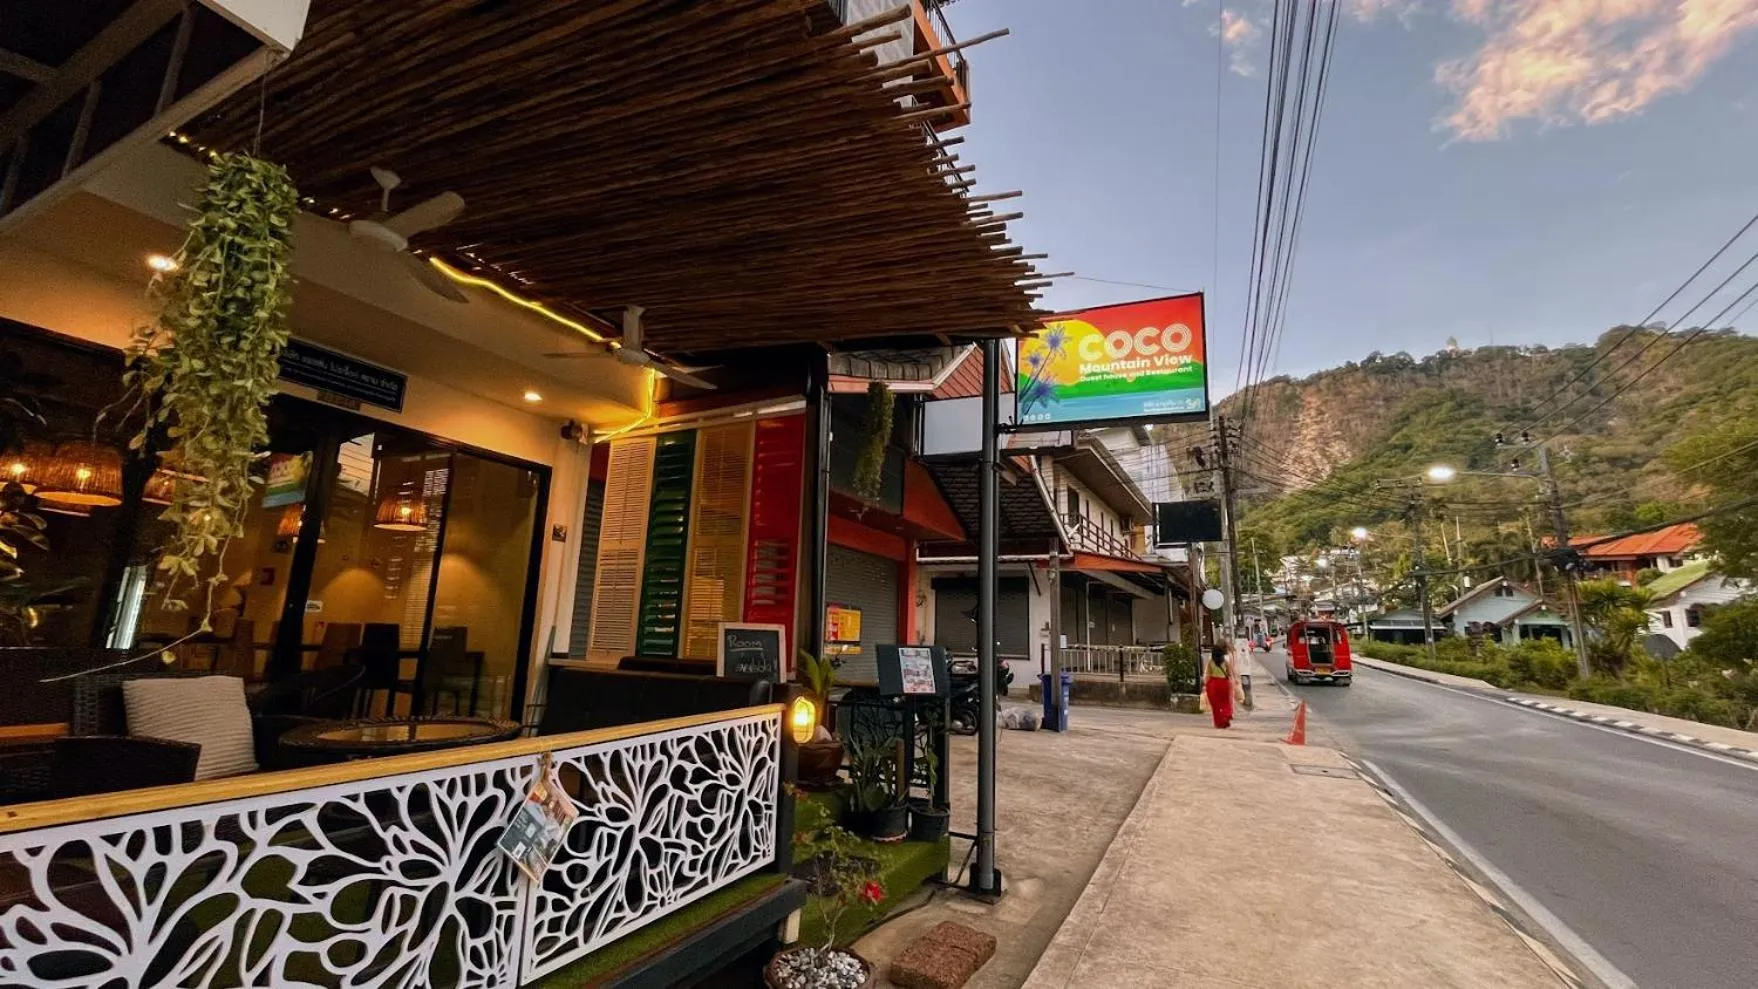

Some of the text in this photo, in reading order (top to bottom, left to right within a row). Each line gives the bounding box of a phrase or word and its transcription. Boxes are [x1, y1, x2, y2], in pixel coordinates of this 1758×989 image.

[1078, 323, 1193, 361] COCO
[1079, 355, 1193, 374] Mountain View
